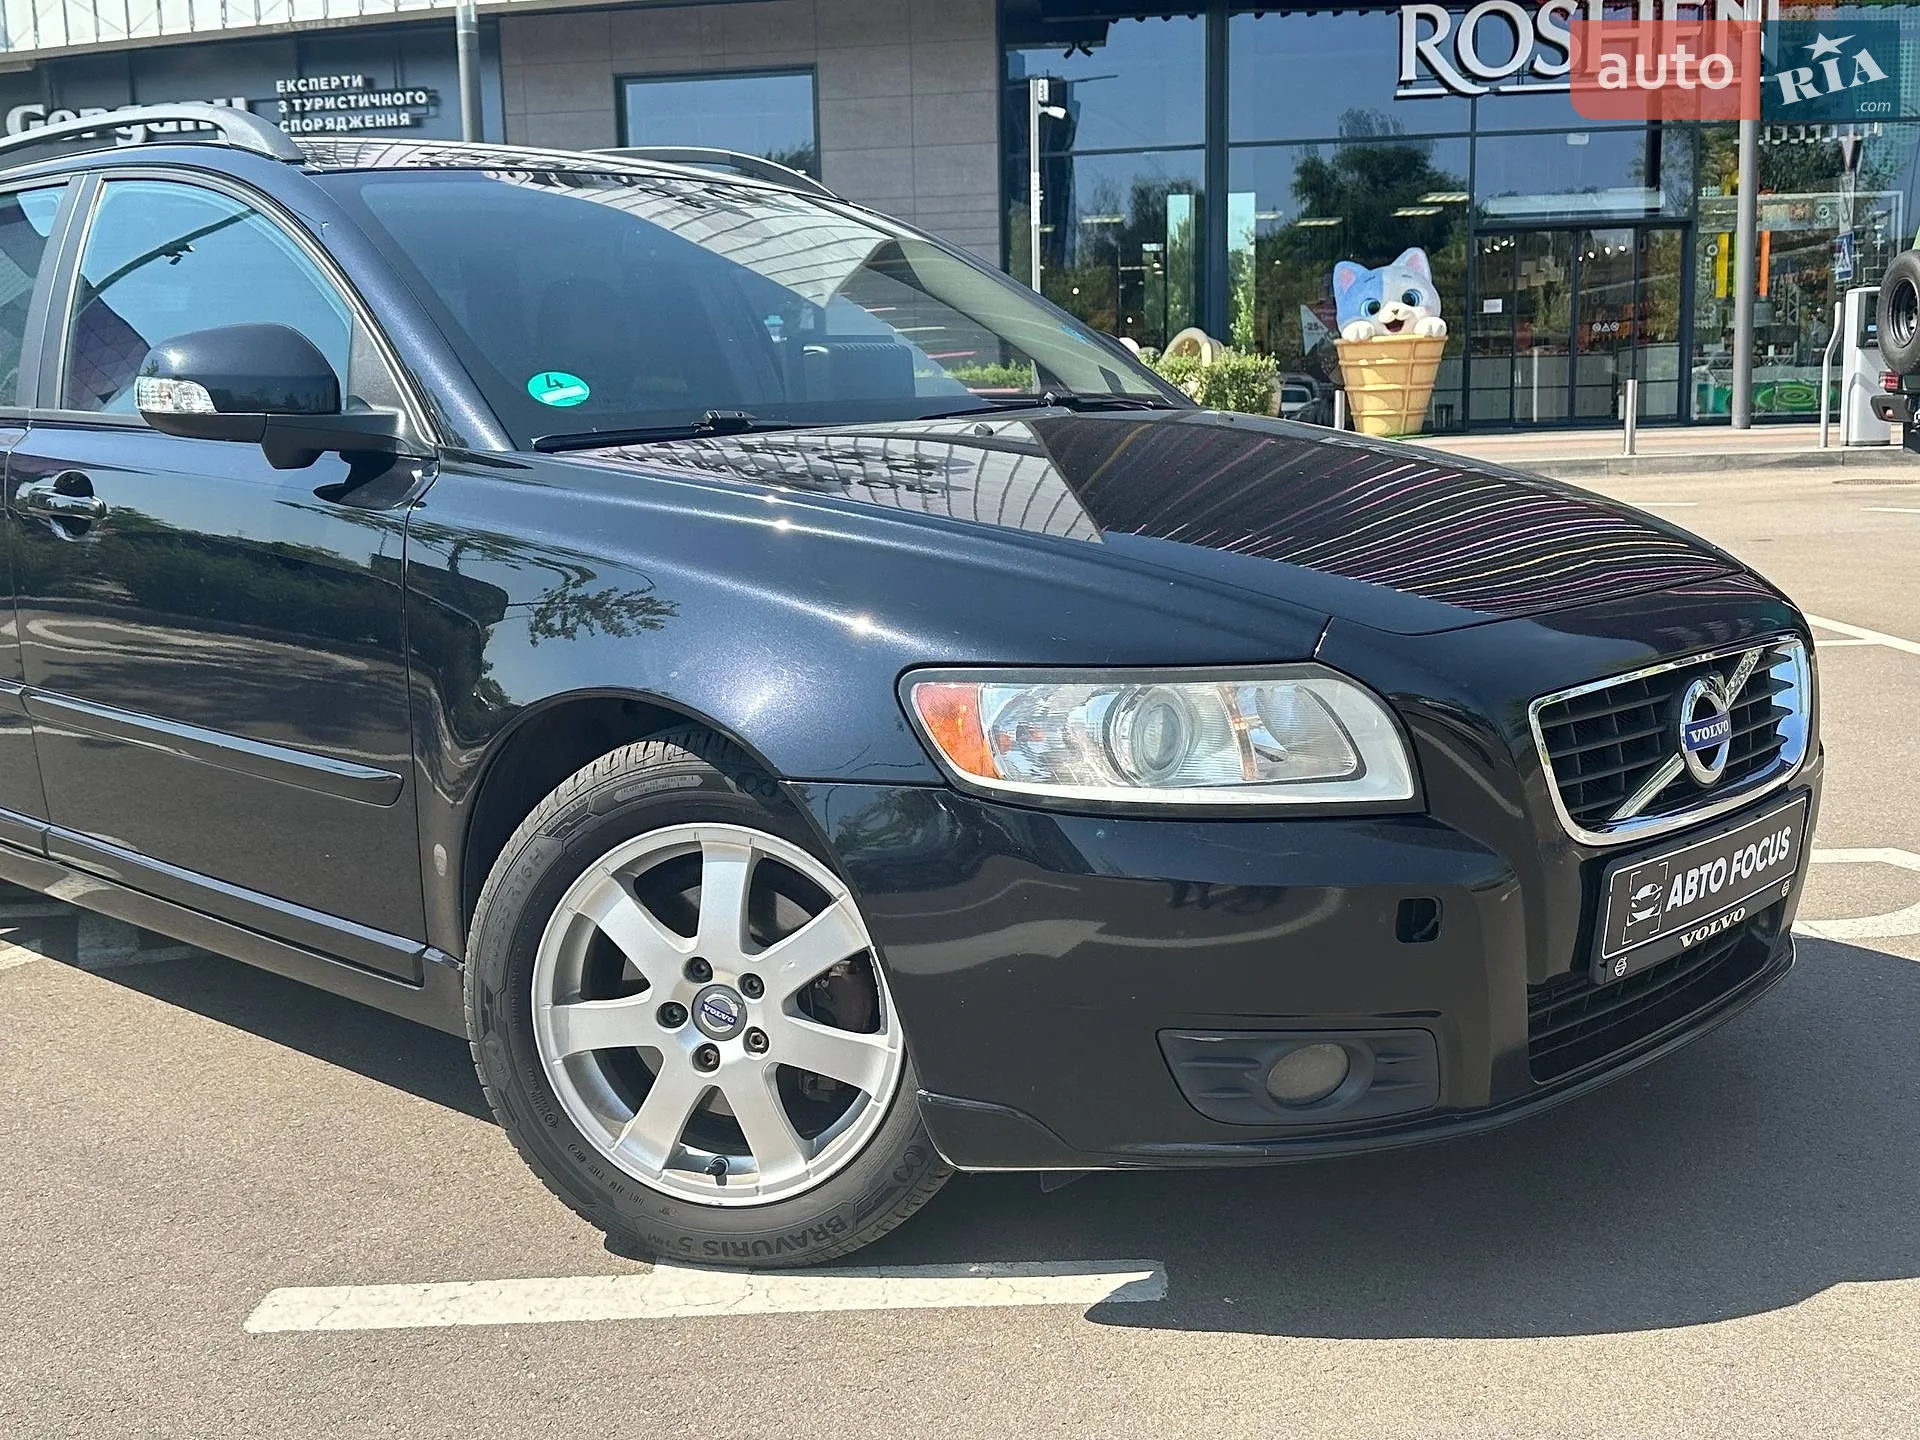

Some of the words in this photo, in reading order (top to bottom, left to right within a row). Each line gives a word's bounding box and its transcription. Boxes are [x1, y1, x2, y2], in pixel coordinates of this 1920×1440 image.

[276, 74, 363, 92] ЕКСПЕРТИ
[292, 90, 428, 112] ТУРИСТИЧНОГО
[279, 112, 410, 133] СПОРЯДЖЕННЯ
[545, 374, 564, 389] 4
[1689, 719, 1730, 745] VOLVO
[1665, 855, 1728, 913] АВТО
[1729, 825, 1793, 887] FOCUS
[1679, 906, 1747, 949] VOLVO
[703, 1003, 735, 1023] VOLVO
[702, 1213, 847, 1259] BRAVURIS
